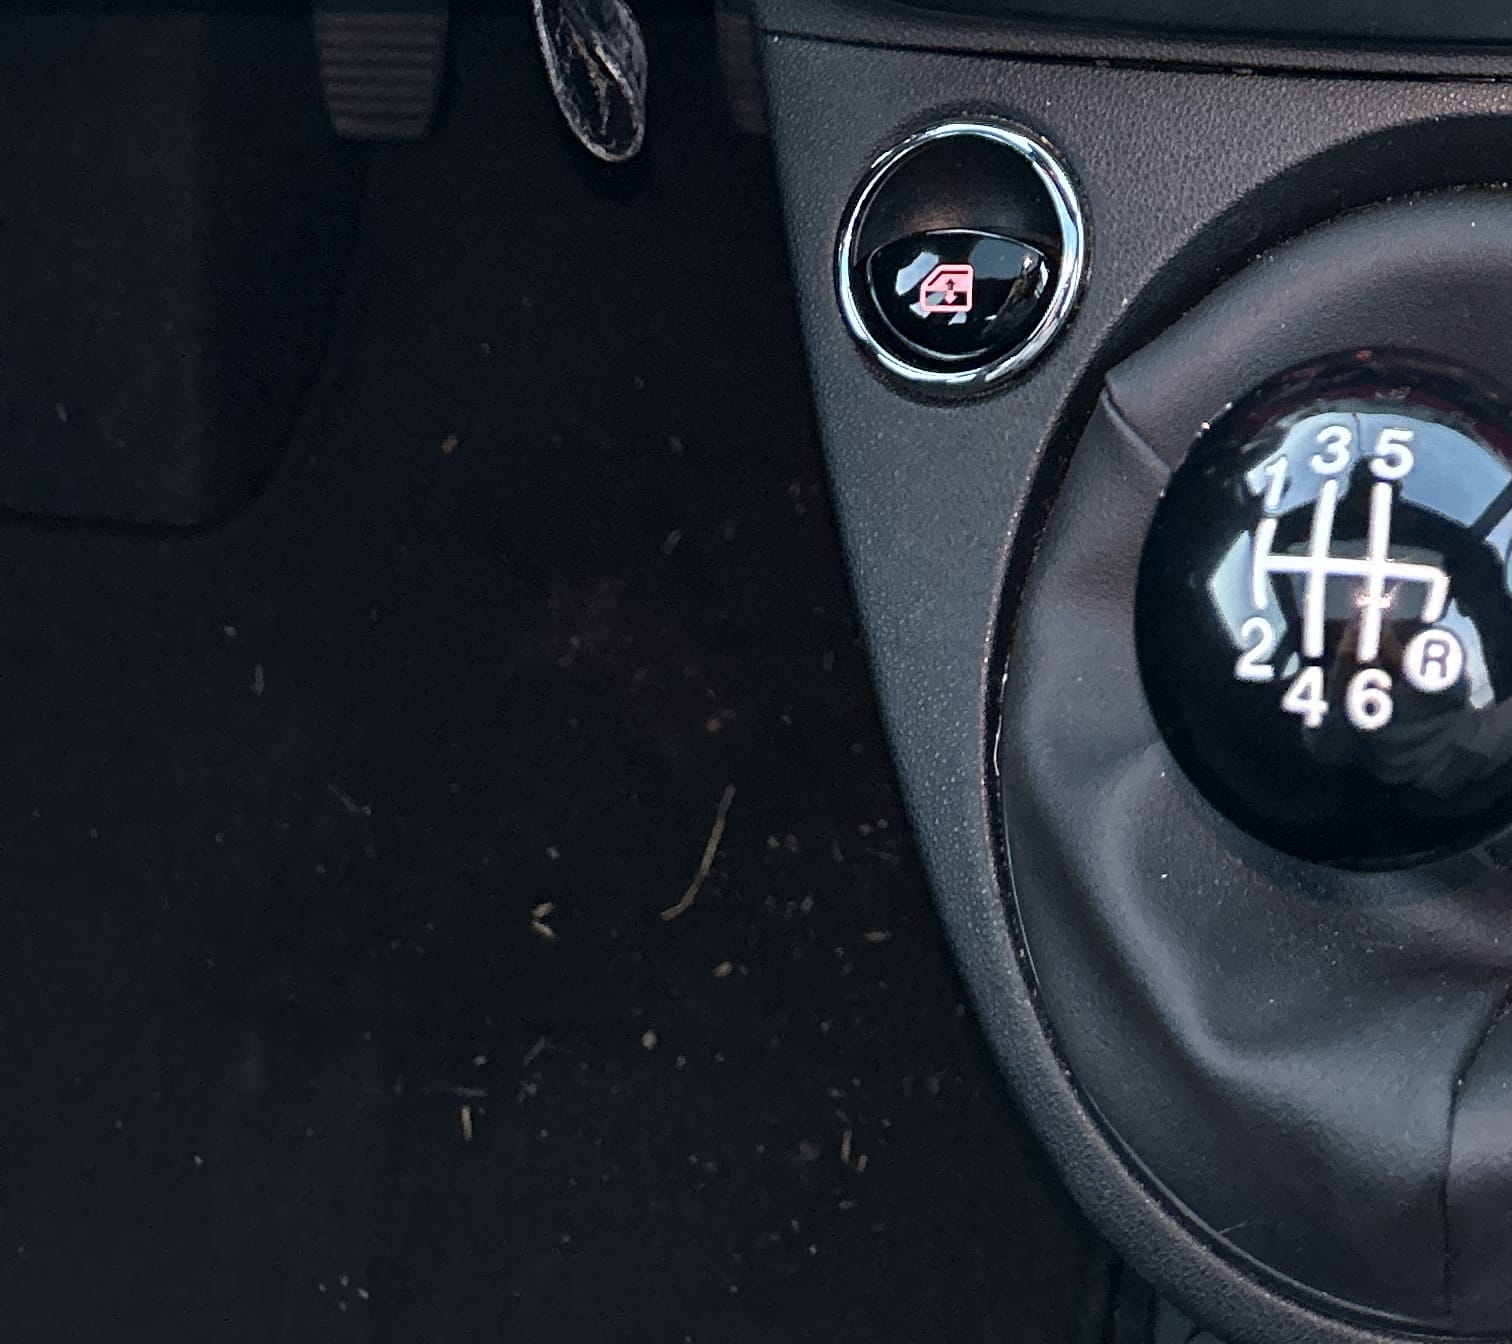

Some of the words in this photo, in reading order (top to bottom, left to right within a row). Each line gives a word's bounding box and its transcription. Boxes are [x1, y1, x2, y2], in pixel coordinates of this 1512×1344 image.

[1311, 425, 1353, 475] 3
[1370, 428, 1414, 480] 5
[1264, 456, 1289, 509] 1
[1234, 617, 1274, 681] 2
[1417, 639, 1452, 678] R
[1282, 666, 1328, 728] 4
[1345, 667, 1393, 729] 6
